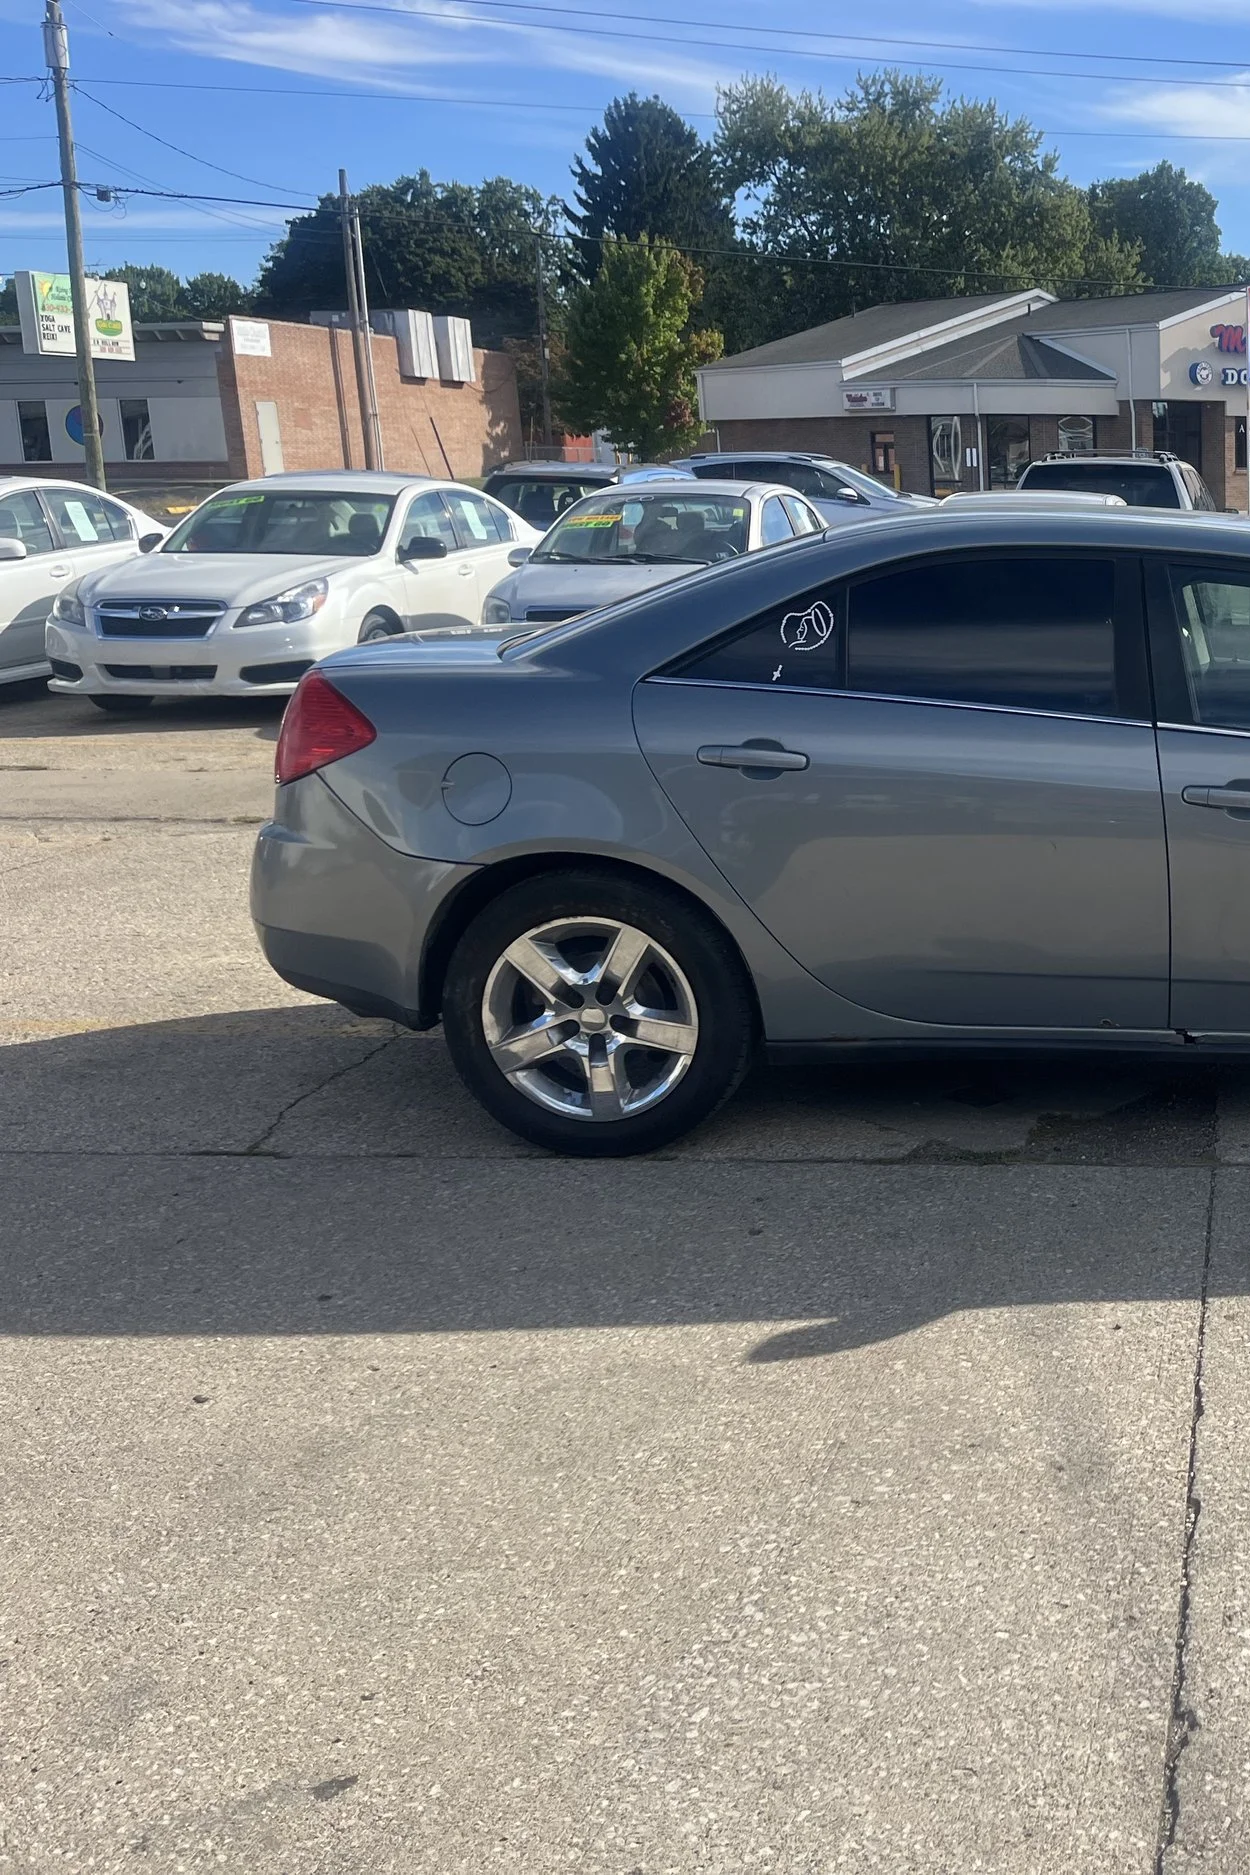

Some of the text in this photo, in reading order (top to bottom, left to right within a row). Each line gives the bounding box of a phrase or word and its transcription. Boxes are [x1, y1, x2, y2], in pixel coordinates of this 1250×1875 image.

[40, 315, 55, 323] YOGA
[42, 324, 71, 334] SALT CAVE
[42, 333, 57, 341] REIKI
[1239, 424, 1245, 433] A
